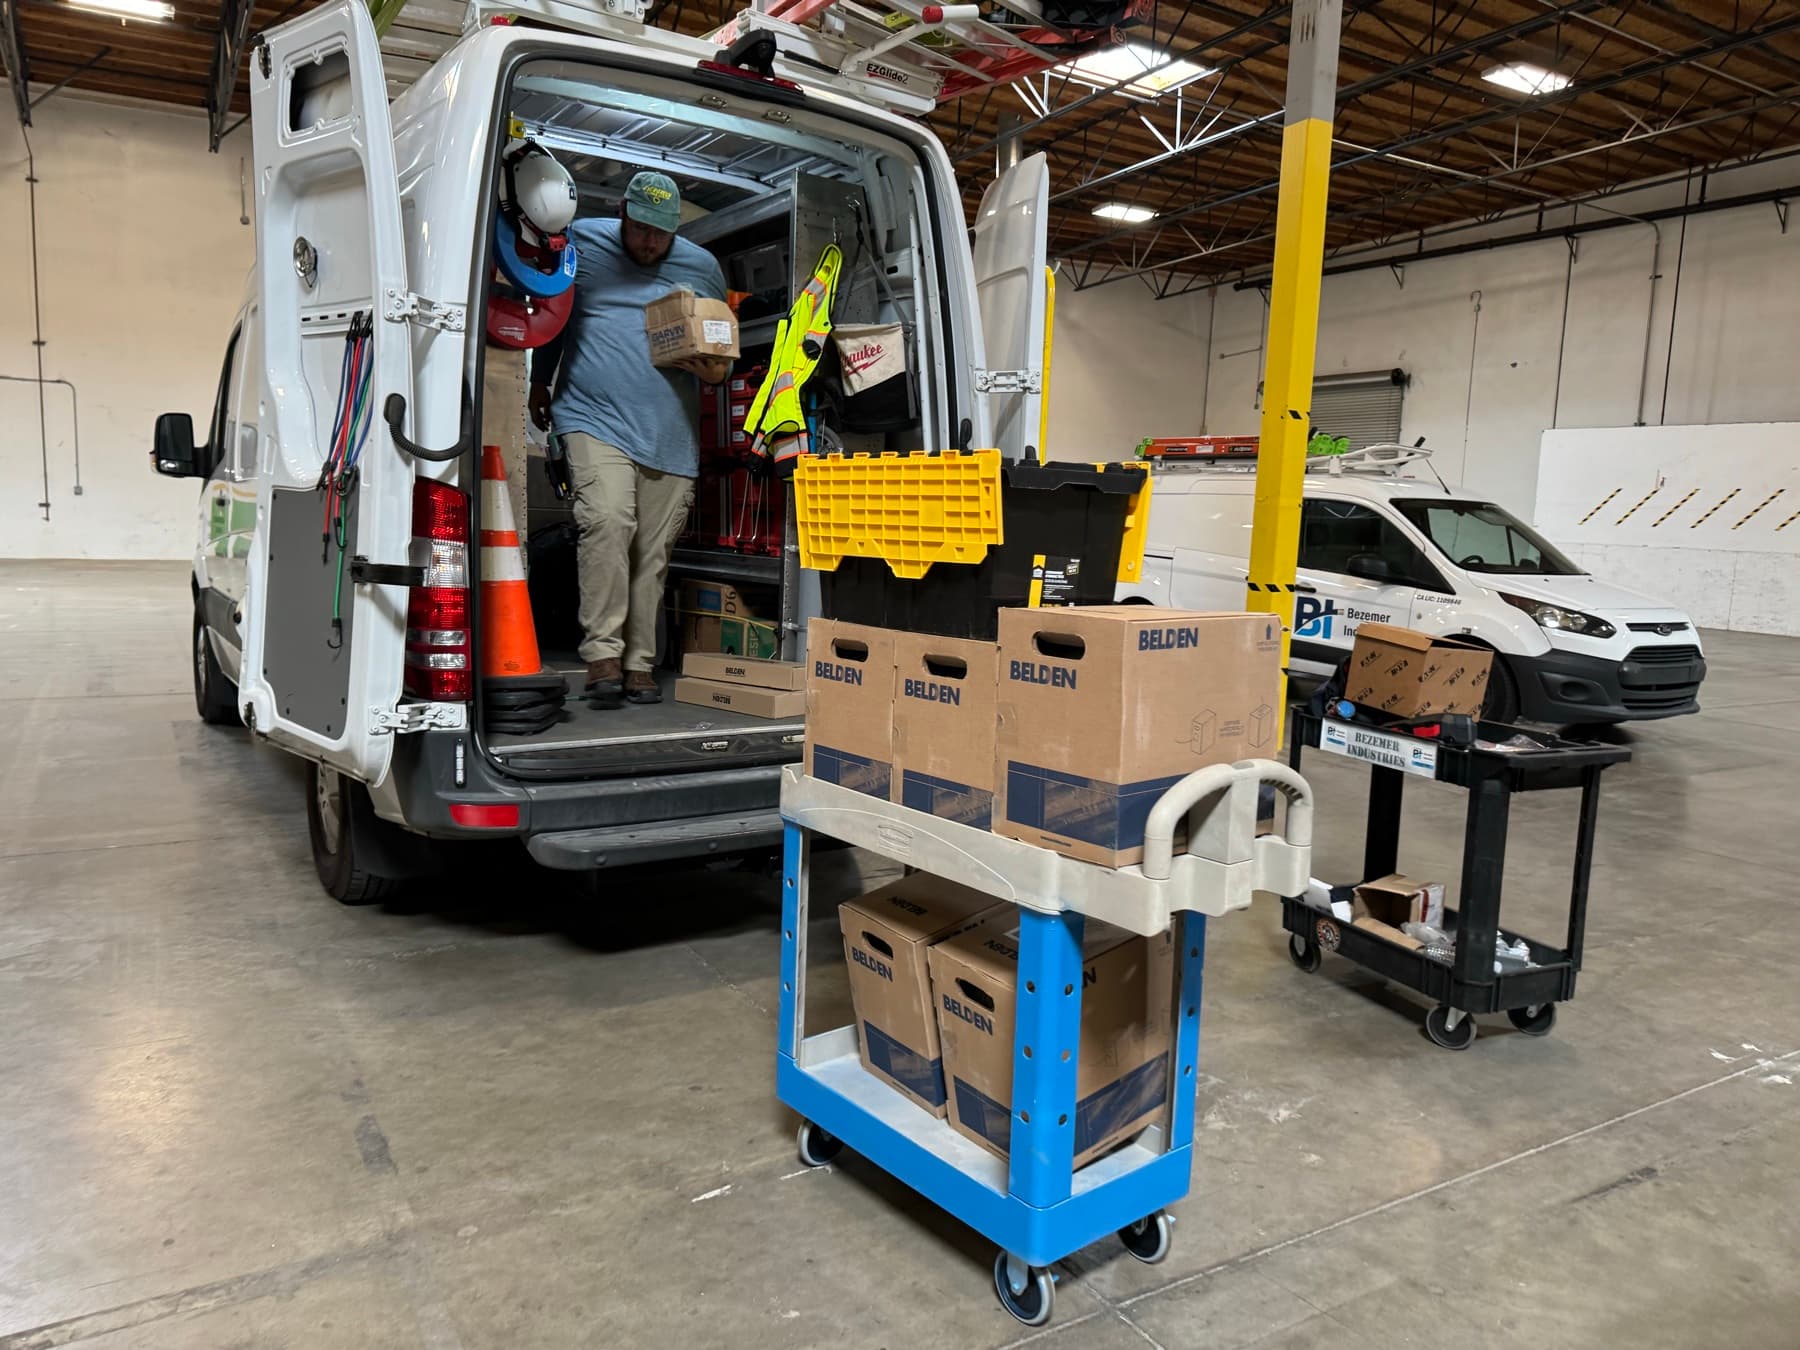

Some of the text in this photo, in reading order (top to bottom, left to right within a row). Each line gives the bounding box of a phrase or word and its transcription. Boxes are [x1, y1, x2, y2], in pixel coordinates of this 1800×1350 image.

[1347, 608, 1391, 623] Bezemer
[1138, 627, 1199, 651] BELDEN
[815, 661, 863, 686] BELDEN
[1010, 660, 1077, 690] BELDEN
[904, 678, 960, 706] BELDEN
[1355, 732, 1400, 752] BEZEMER
[1347, 744, 1405, 767] INDUSTRIES
[852, 947, 893, 982] BELDEN
[942, 993, 993, 1035] BELDEN
